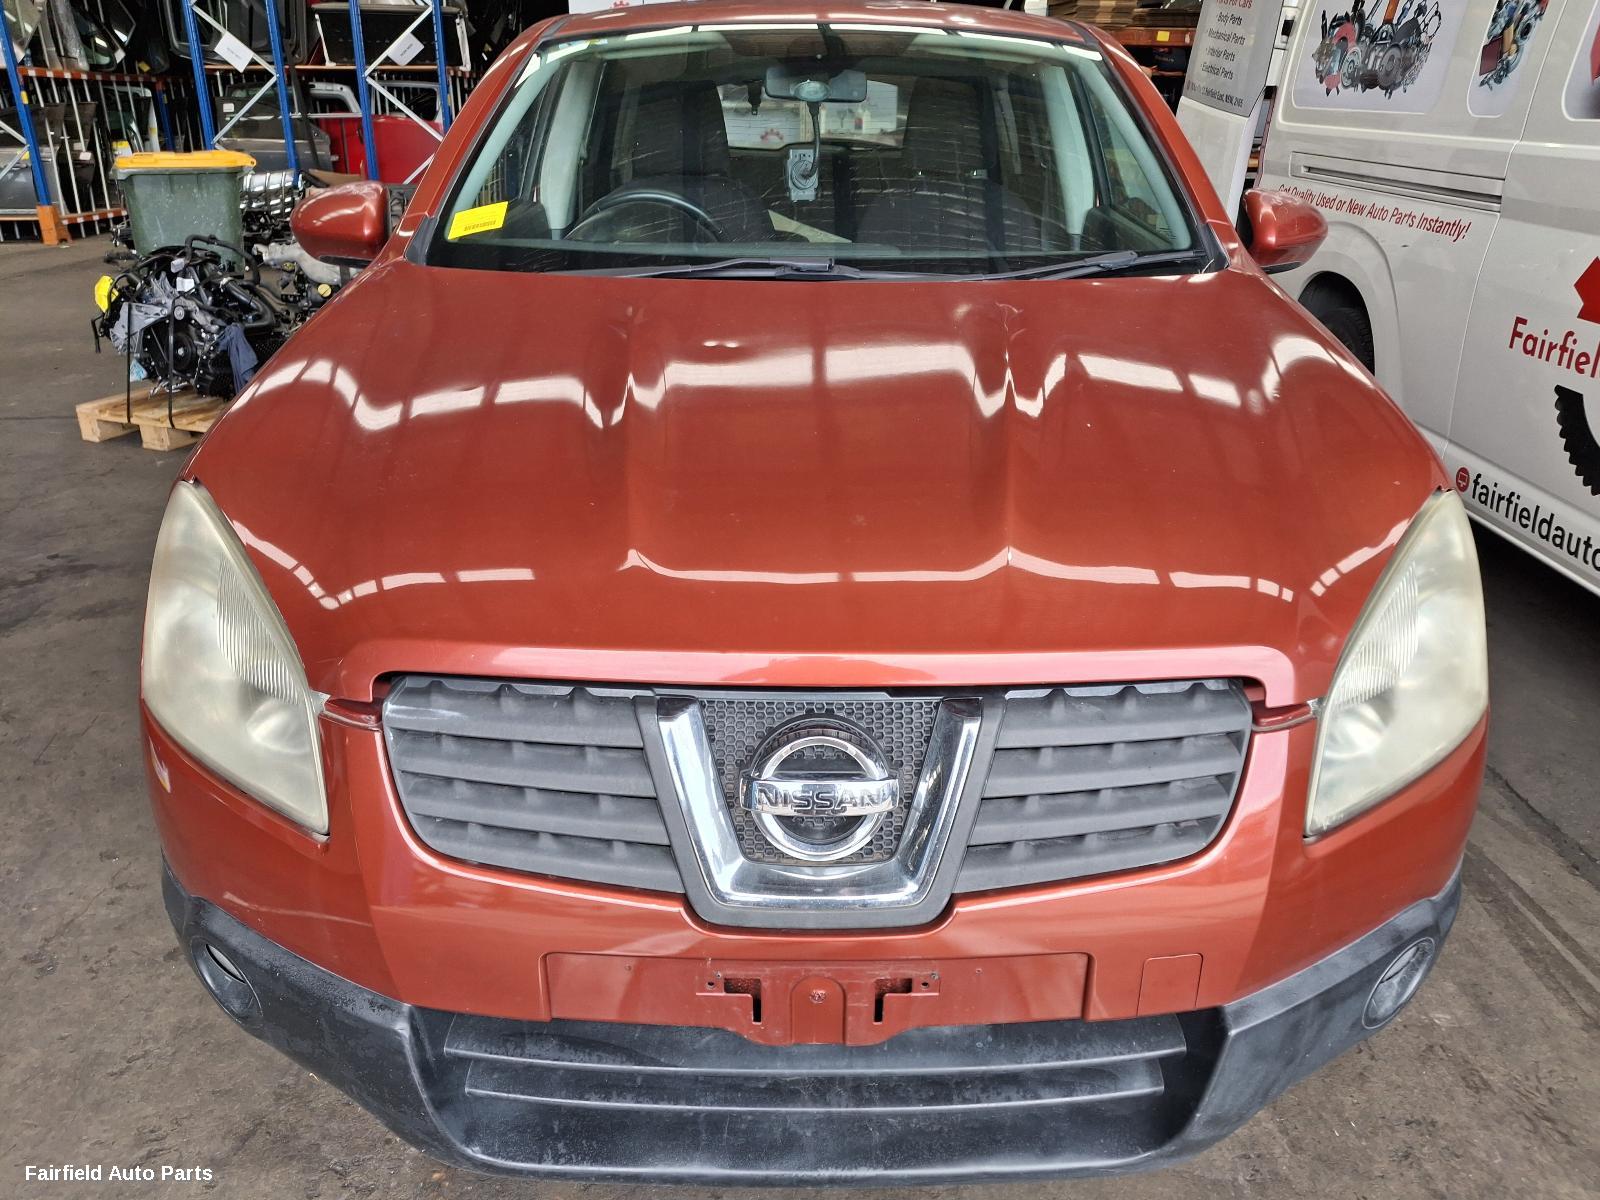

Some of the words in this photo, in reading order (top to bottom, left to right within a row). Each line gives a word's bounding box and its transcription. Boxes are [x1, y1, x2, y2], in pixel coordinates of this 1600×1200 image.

[1217, 11, 1229, 26] Body
[1229, 14, 1243, 26] Parts
[1208, 28, 1231, 43] Mechanical
[1230, 32, 1246, 46] Parts
[1222, 49, 1235, 61] Parts
[1202, 62, 1221, 77] Electrical
[1220, 67, 1234, 80] Parts
[1315, 192, 1338, 209] Used
[1336, 199, 1348, 212] or
[1345, 198, 1368, 216] New
[1366, 202, 1389, 222] Auto
[1389, 207, 1417, 228] Parts
[1416, 212, 1472, 243] Instantly!
[1508, 316, 1600, 378] Fairfiel
[1472, 473, 1600, 572] fairfieldauto
[756, 786, 882, 811] NISSAN
